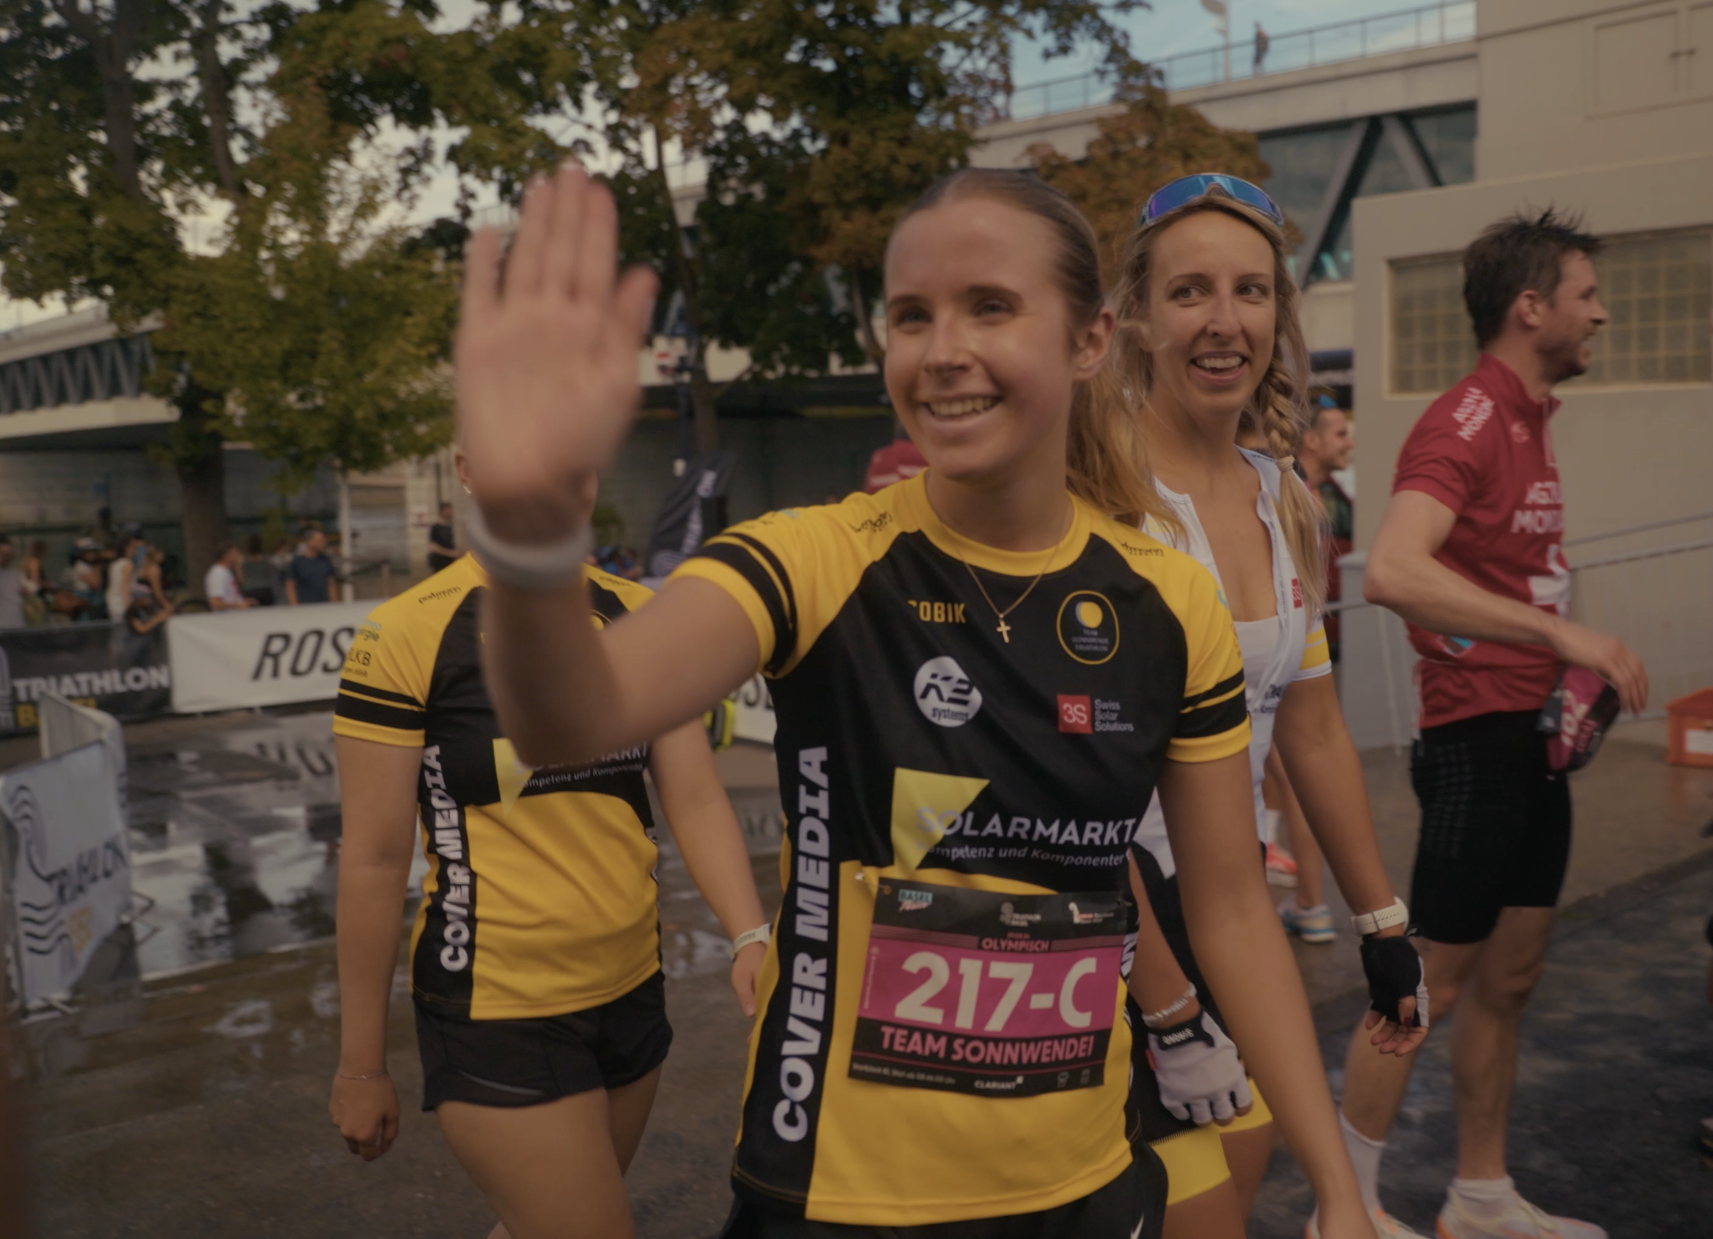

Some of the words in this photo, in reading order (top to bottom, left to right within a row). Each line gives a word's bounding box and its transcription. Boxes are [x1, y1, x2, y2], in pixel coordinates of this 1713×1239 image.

[251, 626, 357, 680] ROS
[12, 665, 169, 702] TRIATHLON
[1063, 703, 1088, 725] 3S
[1095, 699, 1121, 710] Swiss
[1095, 710, 1119, 721] Solar
[1095, 720, 1135, 732] Solutions
[423, 744, 463, 860] MEDIA
[915, 805, 1137, 846] SOLARMARKT
[795, 746, 830, 943] MEDIA
[999, 845, 1027, 858] und
[440, 862, 471, 973] COVER
[981, 937, 1050, 953] OLYMPISCH
[894, 950, 1098, 1032] 217-C
[773, 951, 829, 1143] COVER
[880, 1025, 948, 1060] TEAM
[974, 1079, 1017, 1090] CLARIANT
